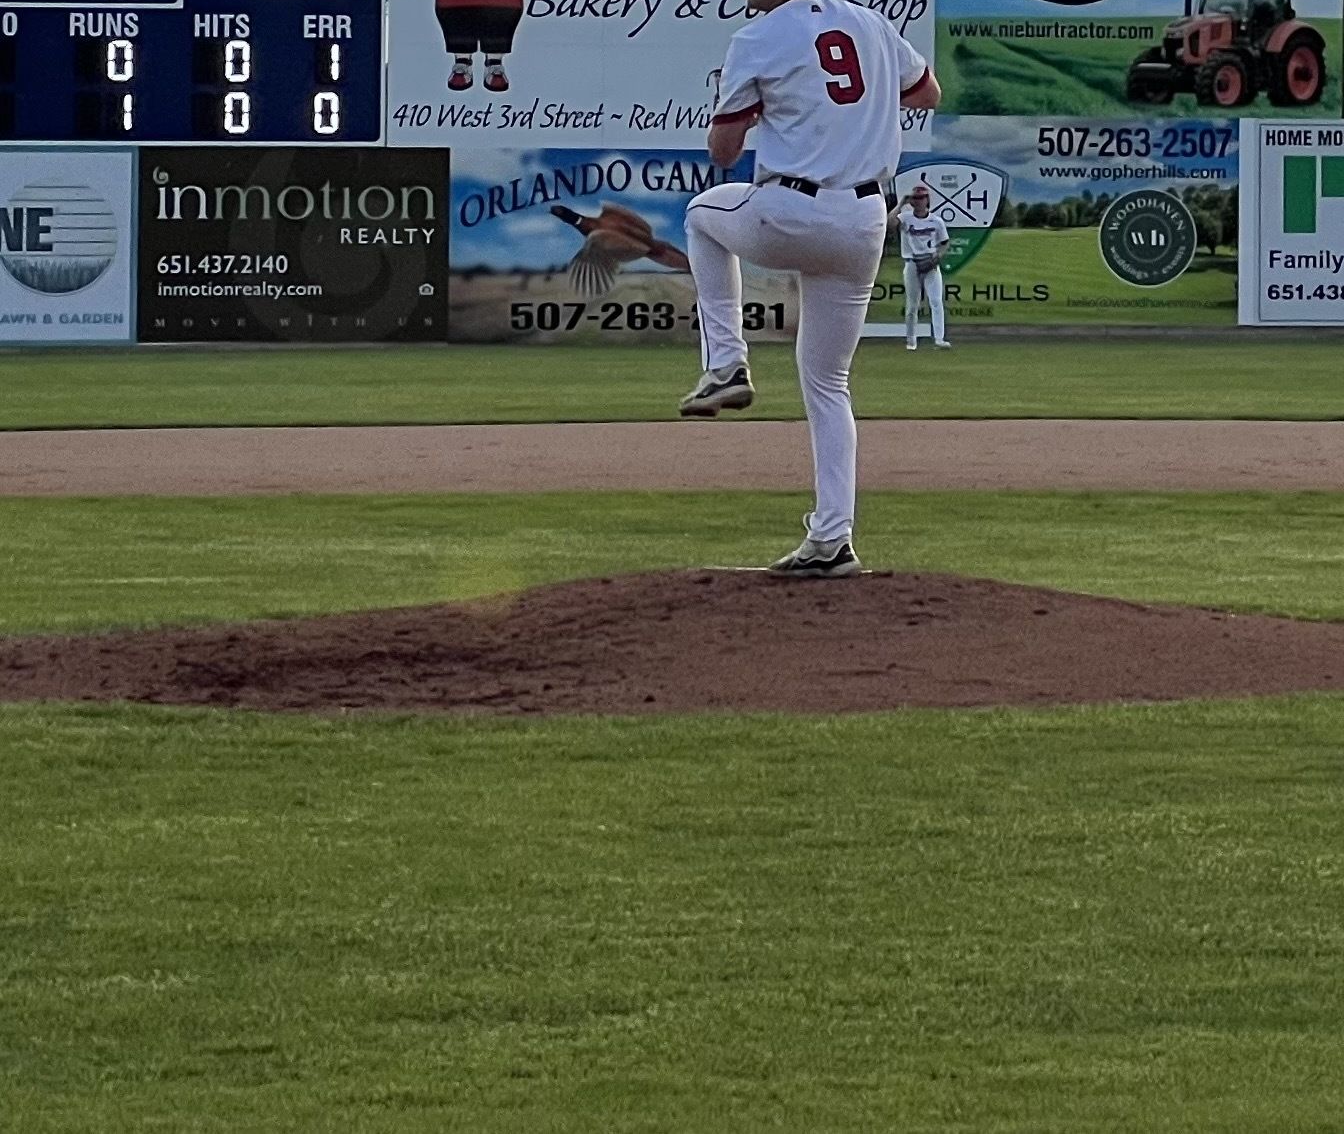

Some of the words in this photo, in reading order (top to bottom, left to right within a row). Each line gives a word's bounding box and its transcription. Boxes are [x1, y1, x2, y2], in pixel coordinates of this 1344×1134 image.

[69, 13, 139, 37] RUNS
[194, 14, 250, 37] HITS
[303, 15, 352, 38] ERR
[949, 21, 1153, 41] www.nieburtractor.com
[107, 40, 133, 81] 0
[225, 40, 250, 82] 0
[331, 43, 339, 80] 1
[815, 30, 865, 104] 9
[123, 94, 132, 130] 1
[224, 92, 250, 134] 0
[314, 92, 339, 134] 0
[392, 103, 433, 130] 410
[437, 105, 492, 128] West
[497, 97, 535, 129] 3rd
[539, 103, 603, 129] Street
[628, 99, 671, 130] Red
[1038, 126, 1233, 159] 507-263-2507
[1265, 130, 1312, 146] HOME
[1039, 165, 1227, 181] www.gopherhills.com
[153, 166, 436, 221] inmotion
[459, 159, 632, 227] ORLANDO
[1109, 198, 1185, 231] WOODHAVEN
[340, 228, 436, 244] REALTY
[157, 254, 289, 274] 651.437.2140
[1269, 250, 1344, 274] Family
[158, 282, 323, 300] inmotionrealty.com
[973, 284, 1050, 301] HILLS
[59, 314, 123, 324] GARDEN
